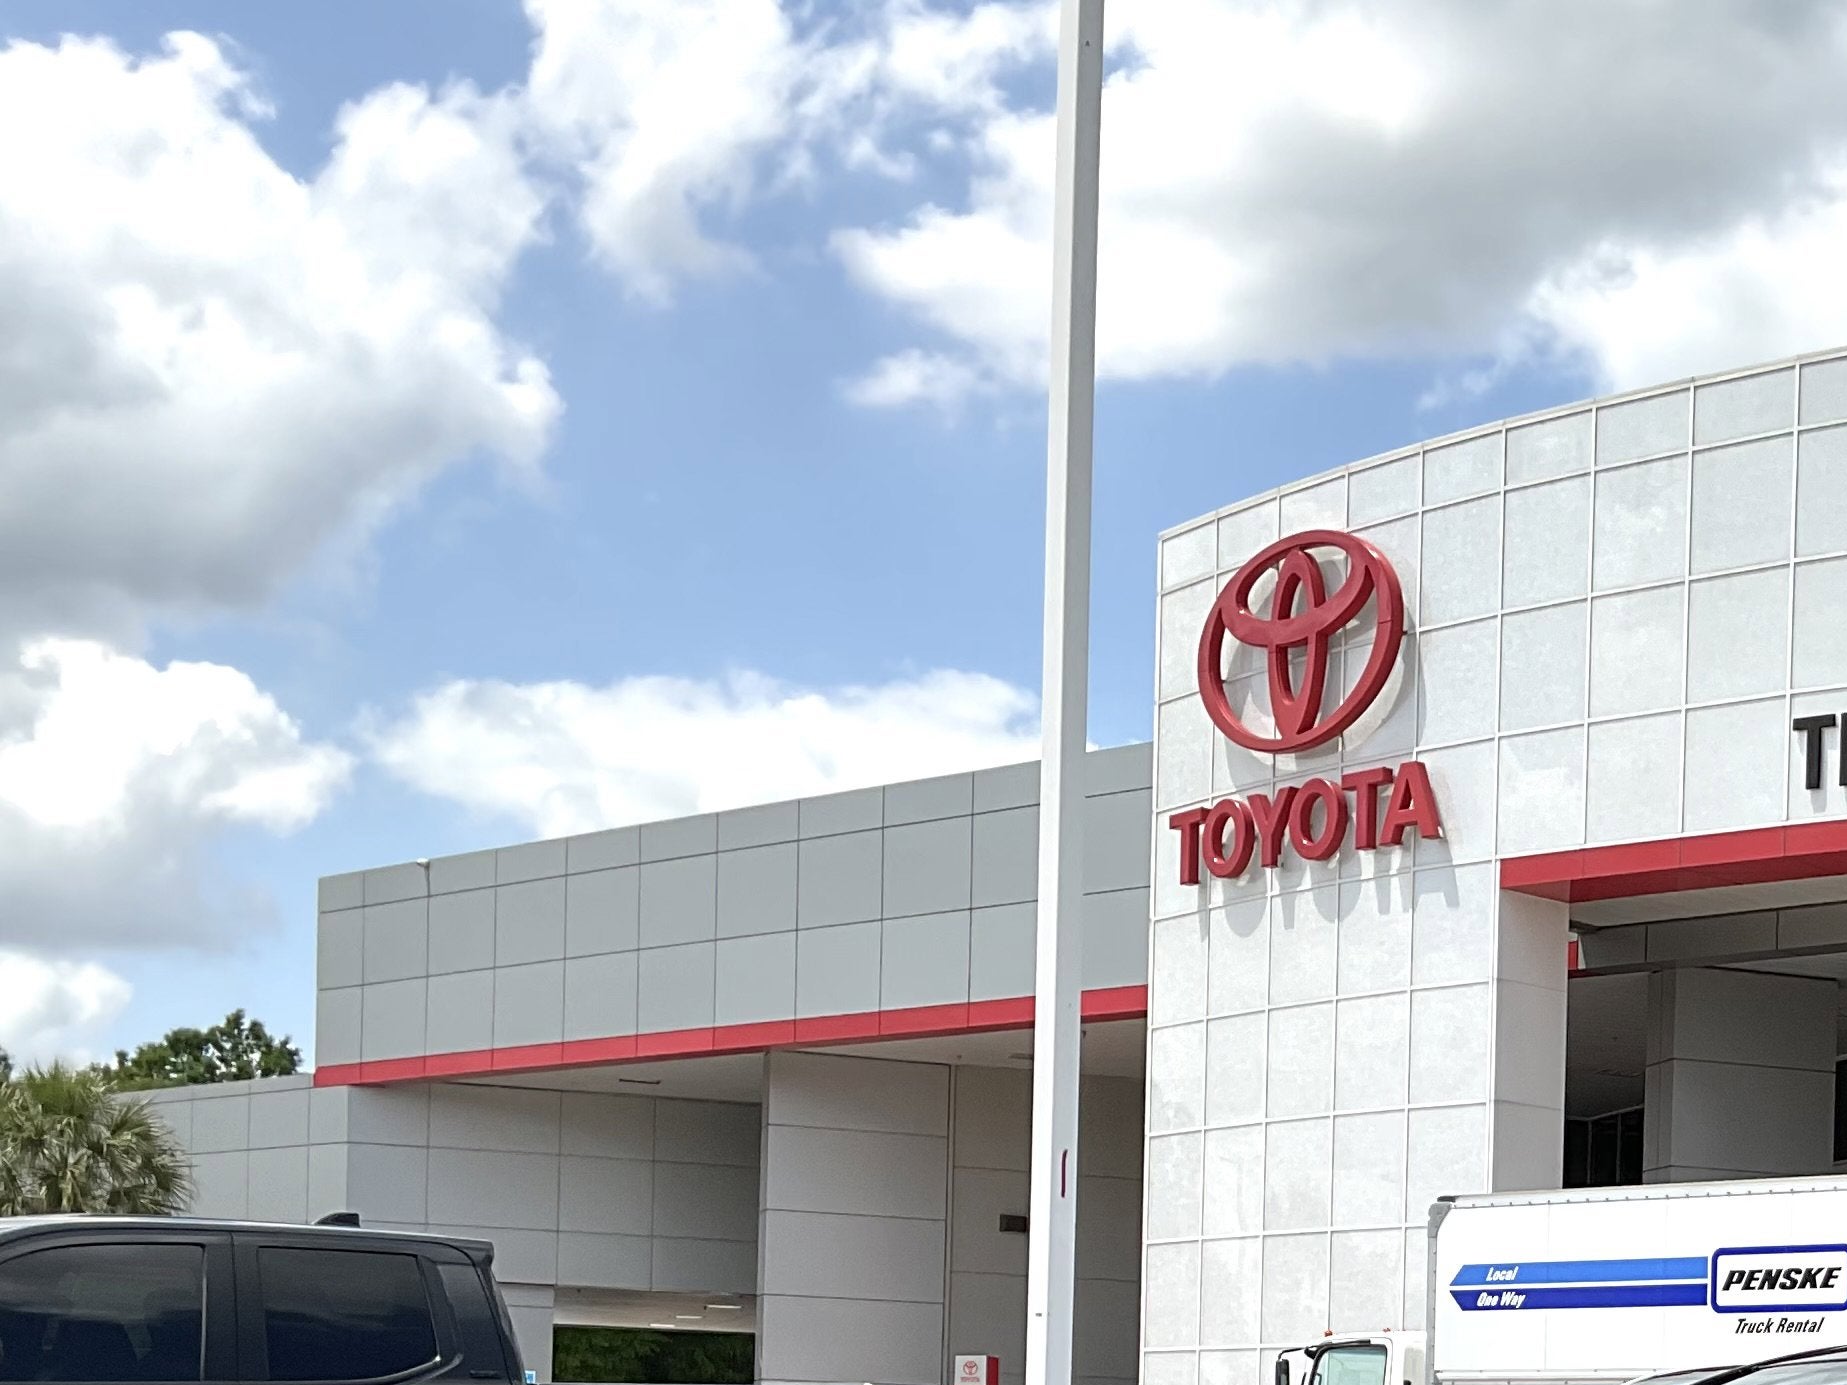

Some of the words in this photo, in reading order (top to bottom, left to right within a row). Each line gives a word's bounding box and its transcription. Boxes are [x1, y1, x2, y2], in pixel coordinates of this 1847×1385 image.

[1169, 761, 1443, 886] TOYOTA
[1486, 1266, 1518, 1281] Local
[1721, 1266, 1842, 1291] PENSKE
[1477, 1292, 1499, 1307] One
[1500, 1292, 1526, 1309] Way
[1735, 1318, 1774, 1334] Truck
[1775, 1317, 1825, 1333] Rental
